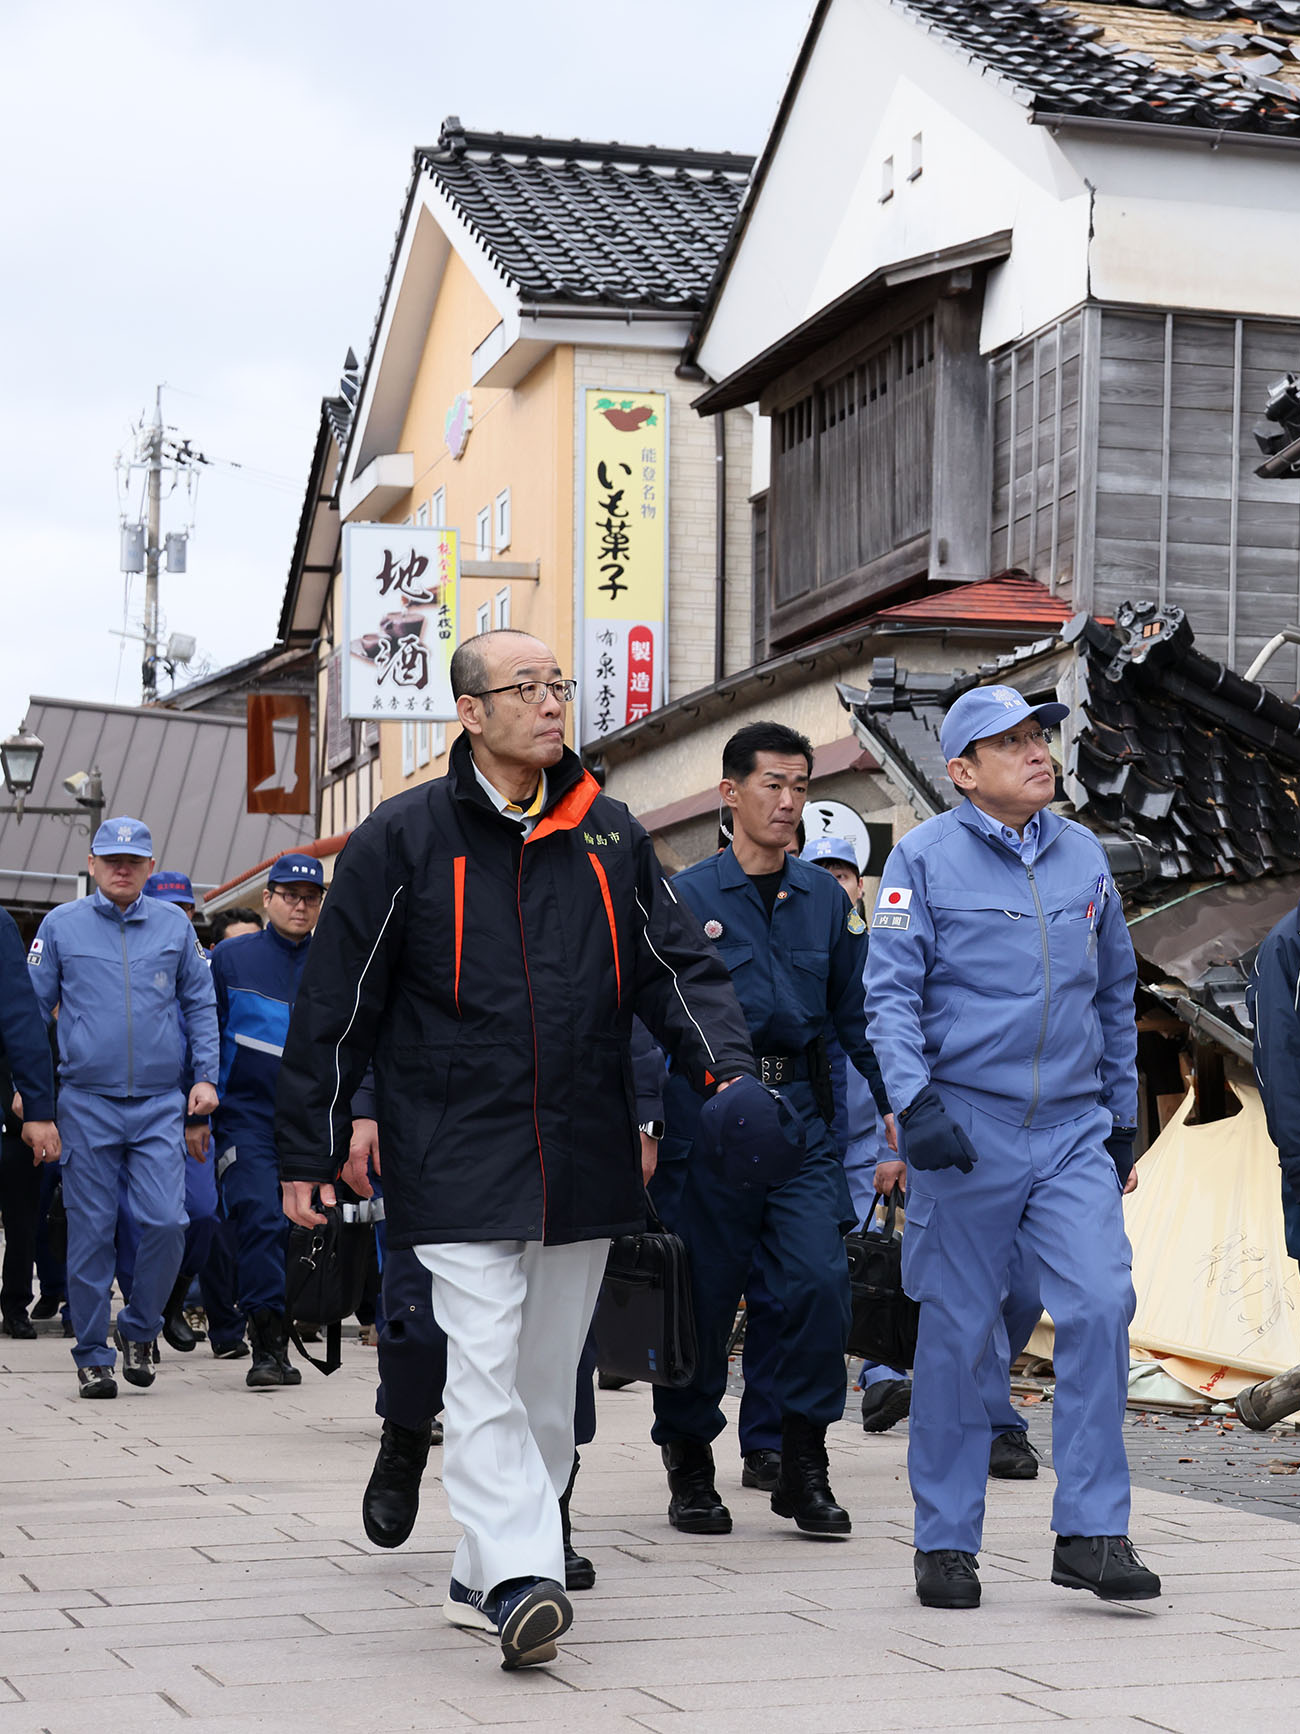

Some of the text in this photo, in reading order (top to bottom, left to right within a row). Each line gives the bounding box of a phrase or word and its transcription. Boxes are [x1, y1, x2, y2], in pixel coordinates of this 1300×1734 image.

[595, 460, 633, 601] いも菓子
[641, 447, 657, 520] 能登名物
[375, 547, 433, 690] 地酒
[630, 640, 651, 722] 製造元
